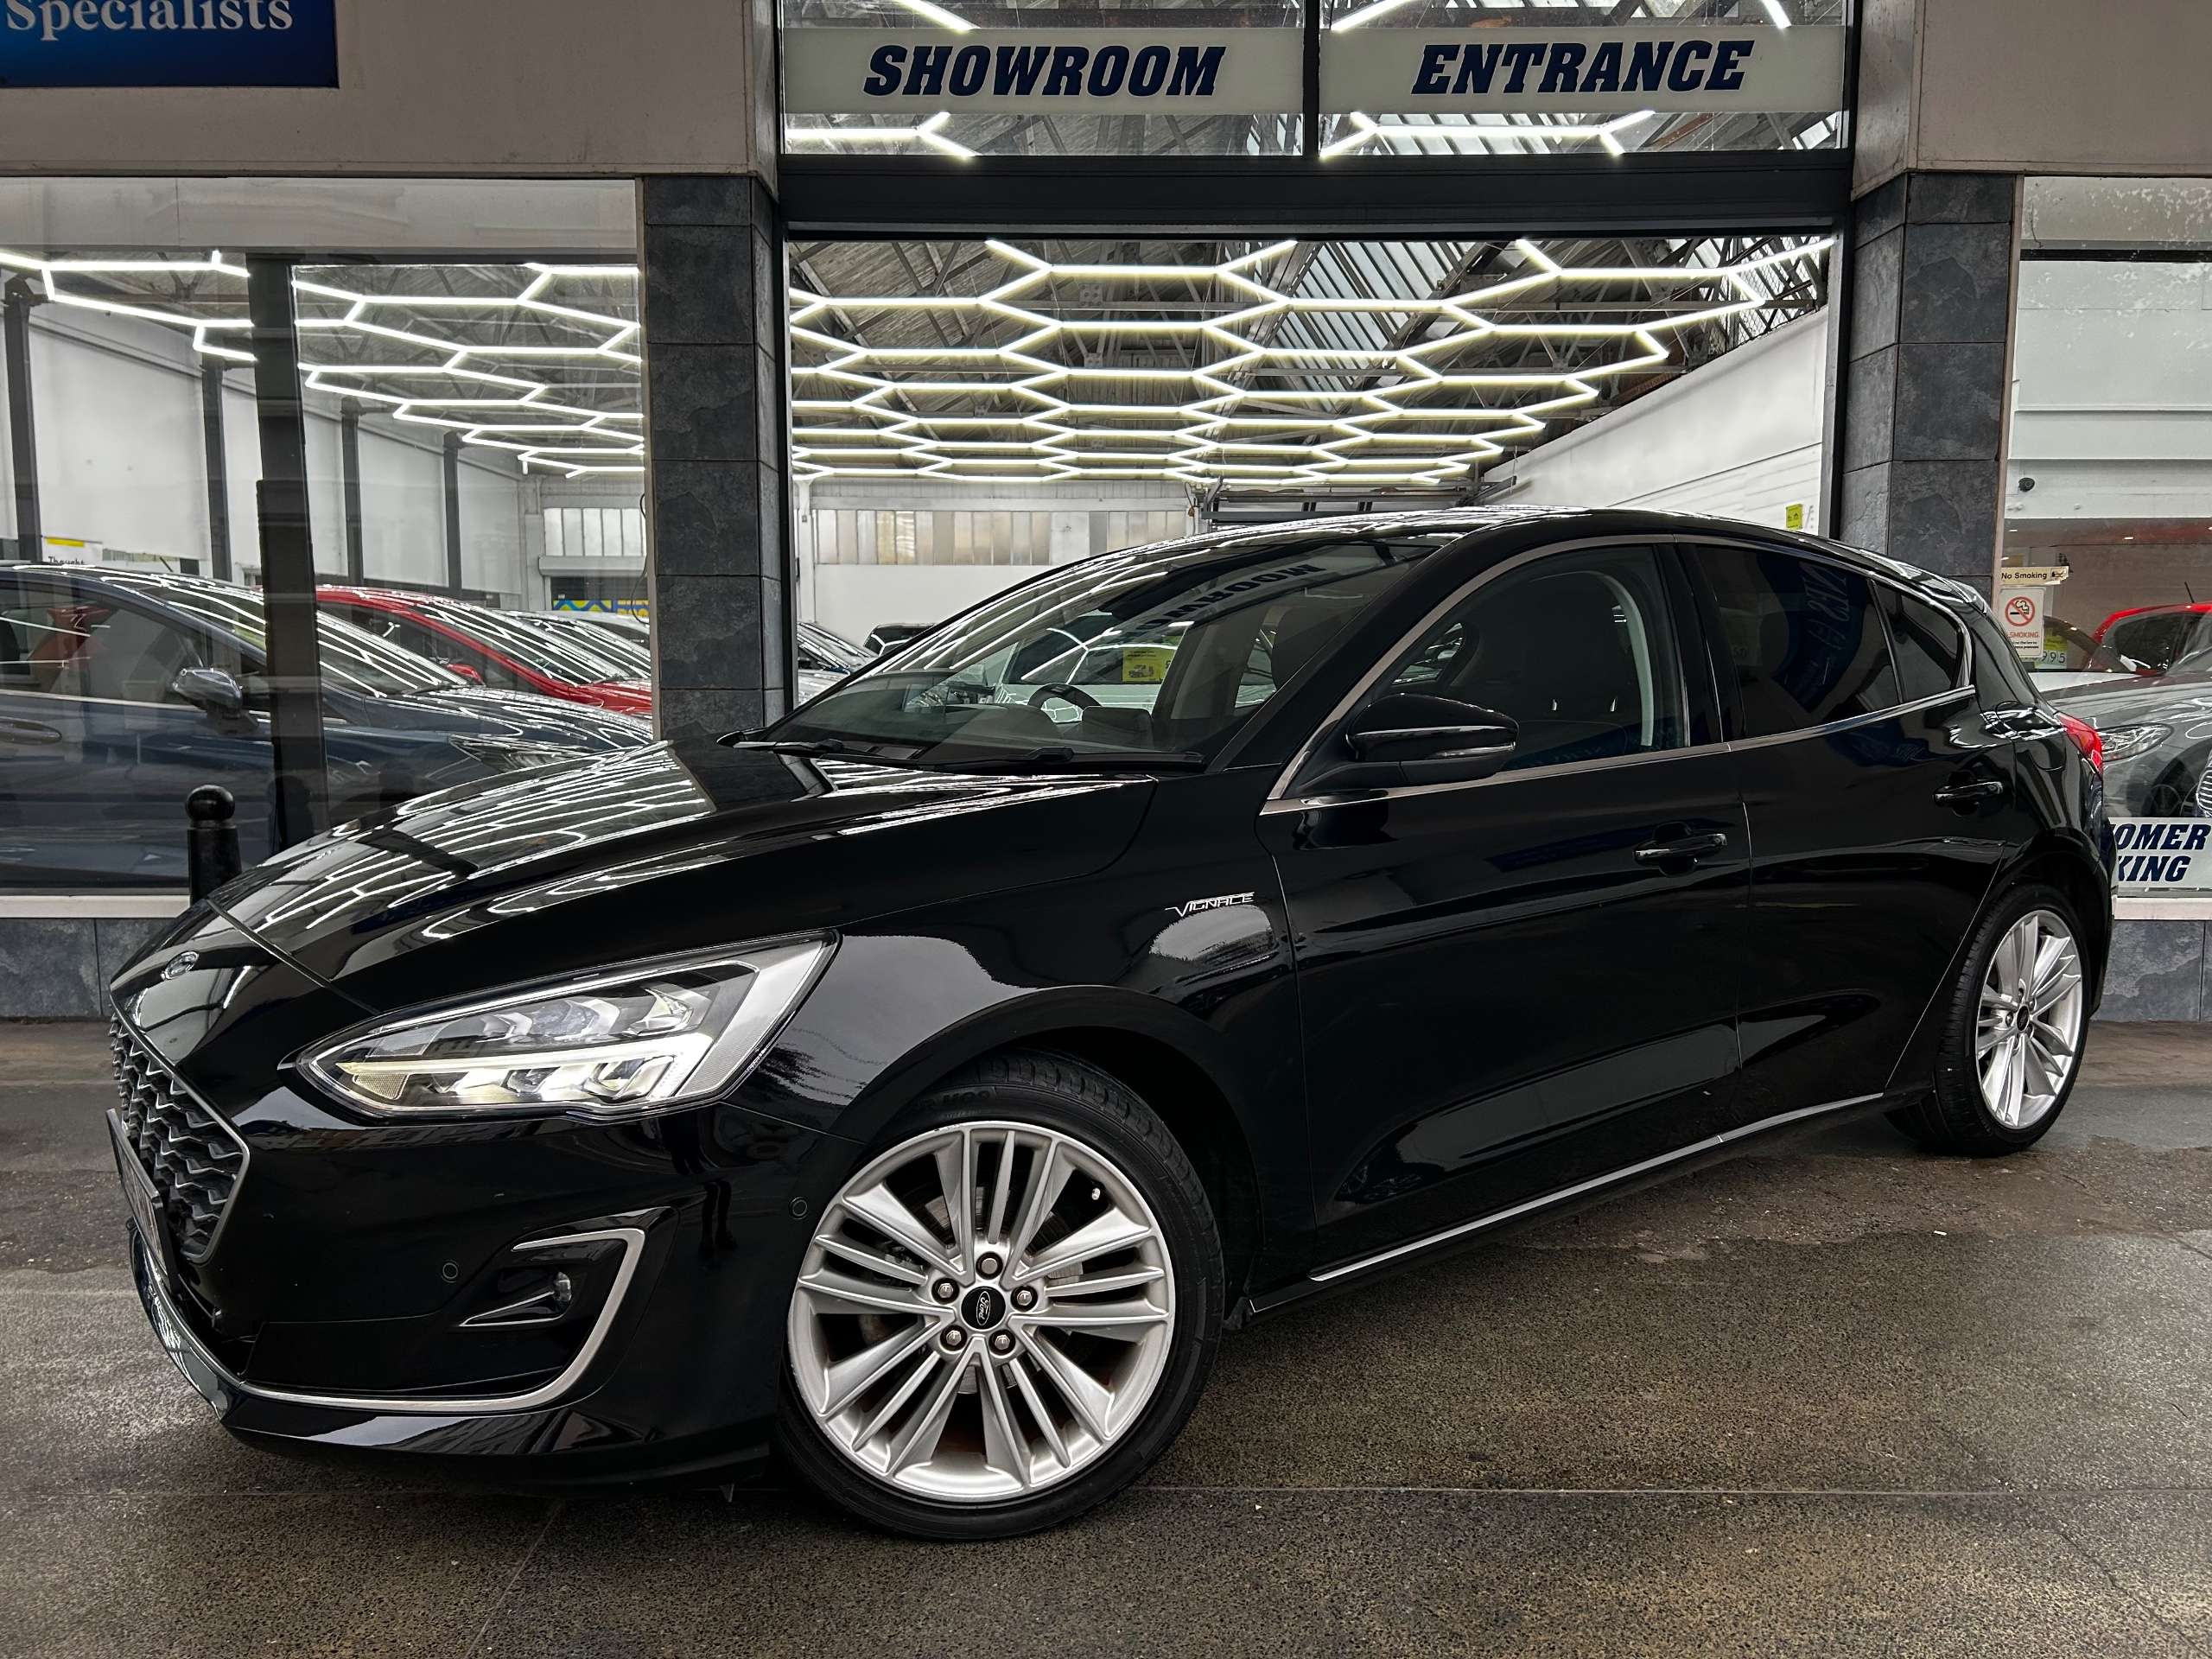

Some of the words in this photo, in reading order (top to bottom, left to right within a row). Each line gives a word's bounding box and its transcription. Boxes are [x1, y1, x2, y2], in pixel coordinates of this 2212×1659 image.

[6, 0, 294, 41] Specialists
[863, 44, 1227, 97] SHOWROOM
[1410, 40, 1756, 94] ENTRANCE
[2110, 823, 2212, 850] OMER
